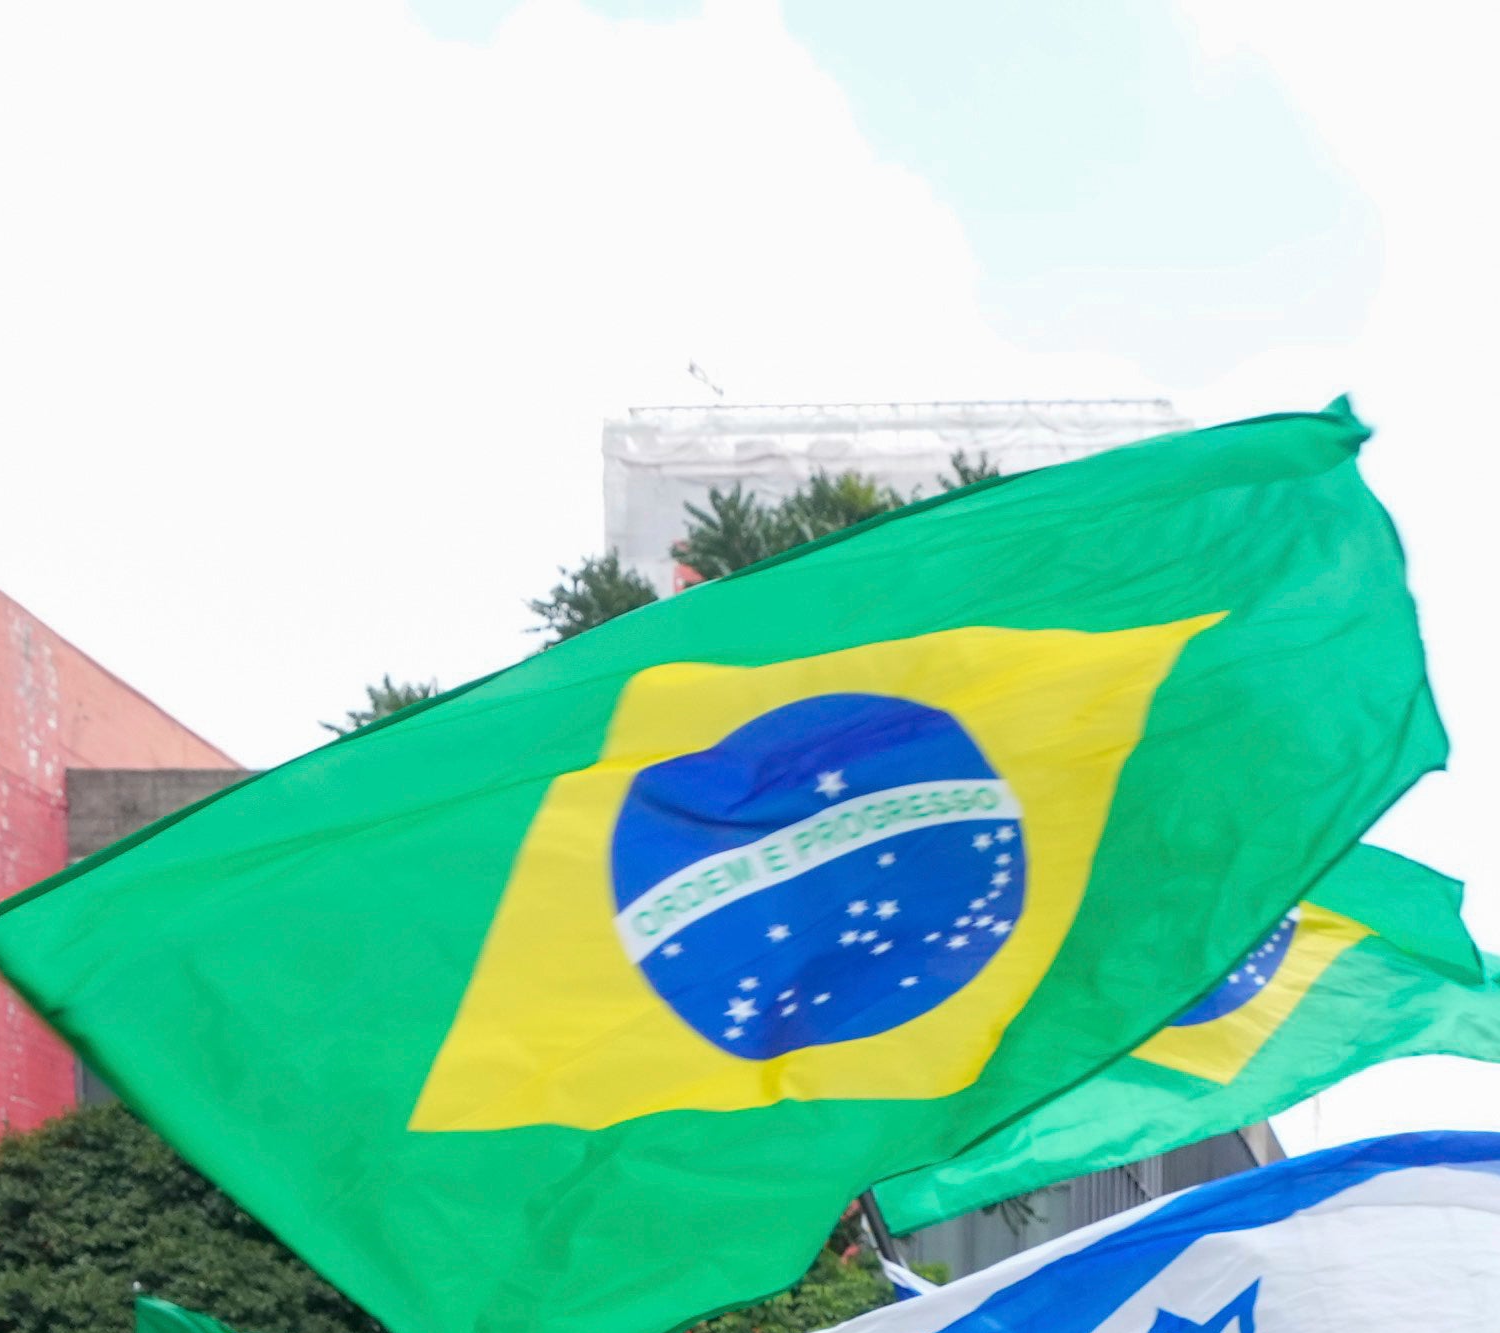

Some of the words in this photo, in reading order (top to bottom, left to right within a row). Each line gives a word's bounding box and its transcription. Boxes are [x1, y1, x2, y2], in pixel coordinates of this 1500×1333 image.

[632, 856, 753, 938] ORDEM
[764, 844, 786, 873] E
[794, 788, 1000, 862] PROGRESSO
